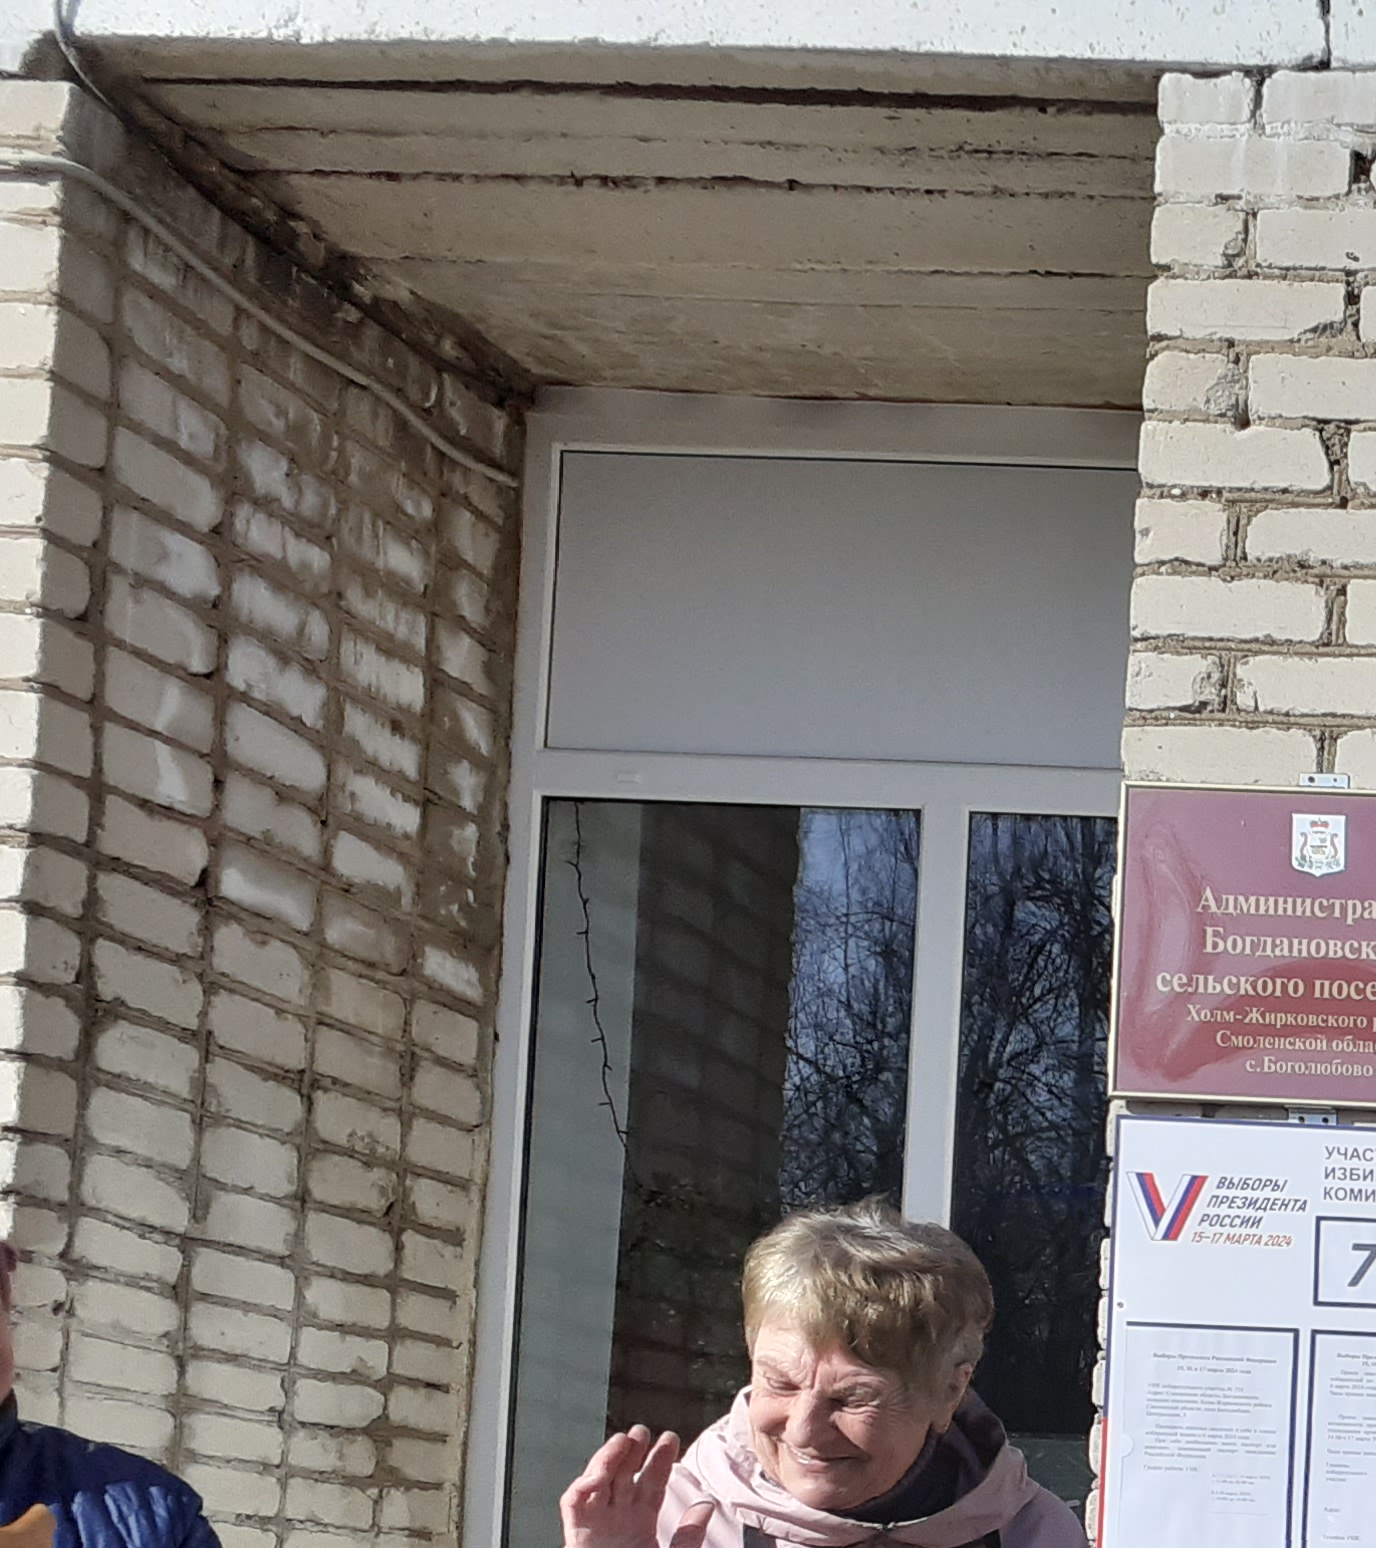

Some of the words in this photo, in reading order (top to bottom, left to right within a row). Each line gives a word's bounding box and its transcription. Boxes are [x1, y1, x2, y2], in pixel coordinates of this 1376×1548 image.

[1155, 970, 1305, 998] сельского
[1186, 1004, 1368, 1030] Холм-Жирковского
[1216, 1029, 1328, 1051] Смоленской
[1215, 1176, 1289, 1193] ВЫБОРЫ
[1206, 1194, 1308, 1213] ПРЕЗИДЕНТА
[1197, 1213, 1264, 1230] РОССИИ
[1223, 1233, 1263, 1246] МАРТА
[1263, 1234, 1293, 1247] 2024
